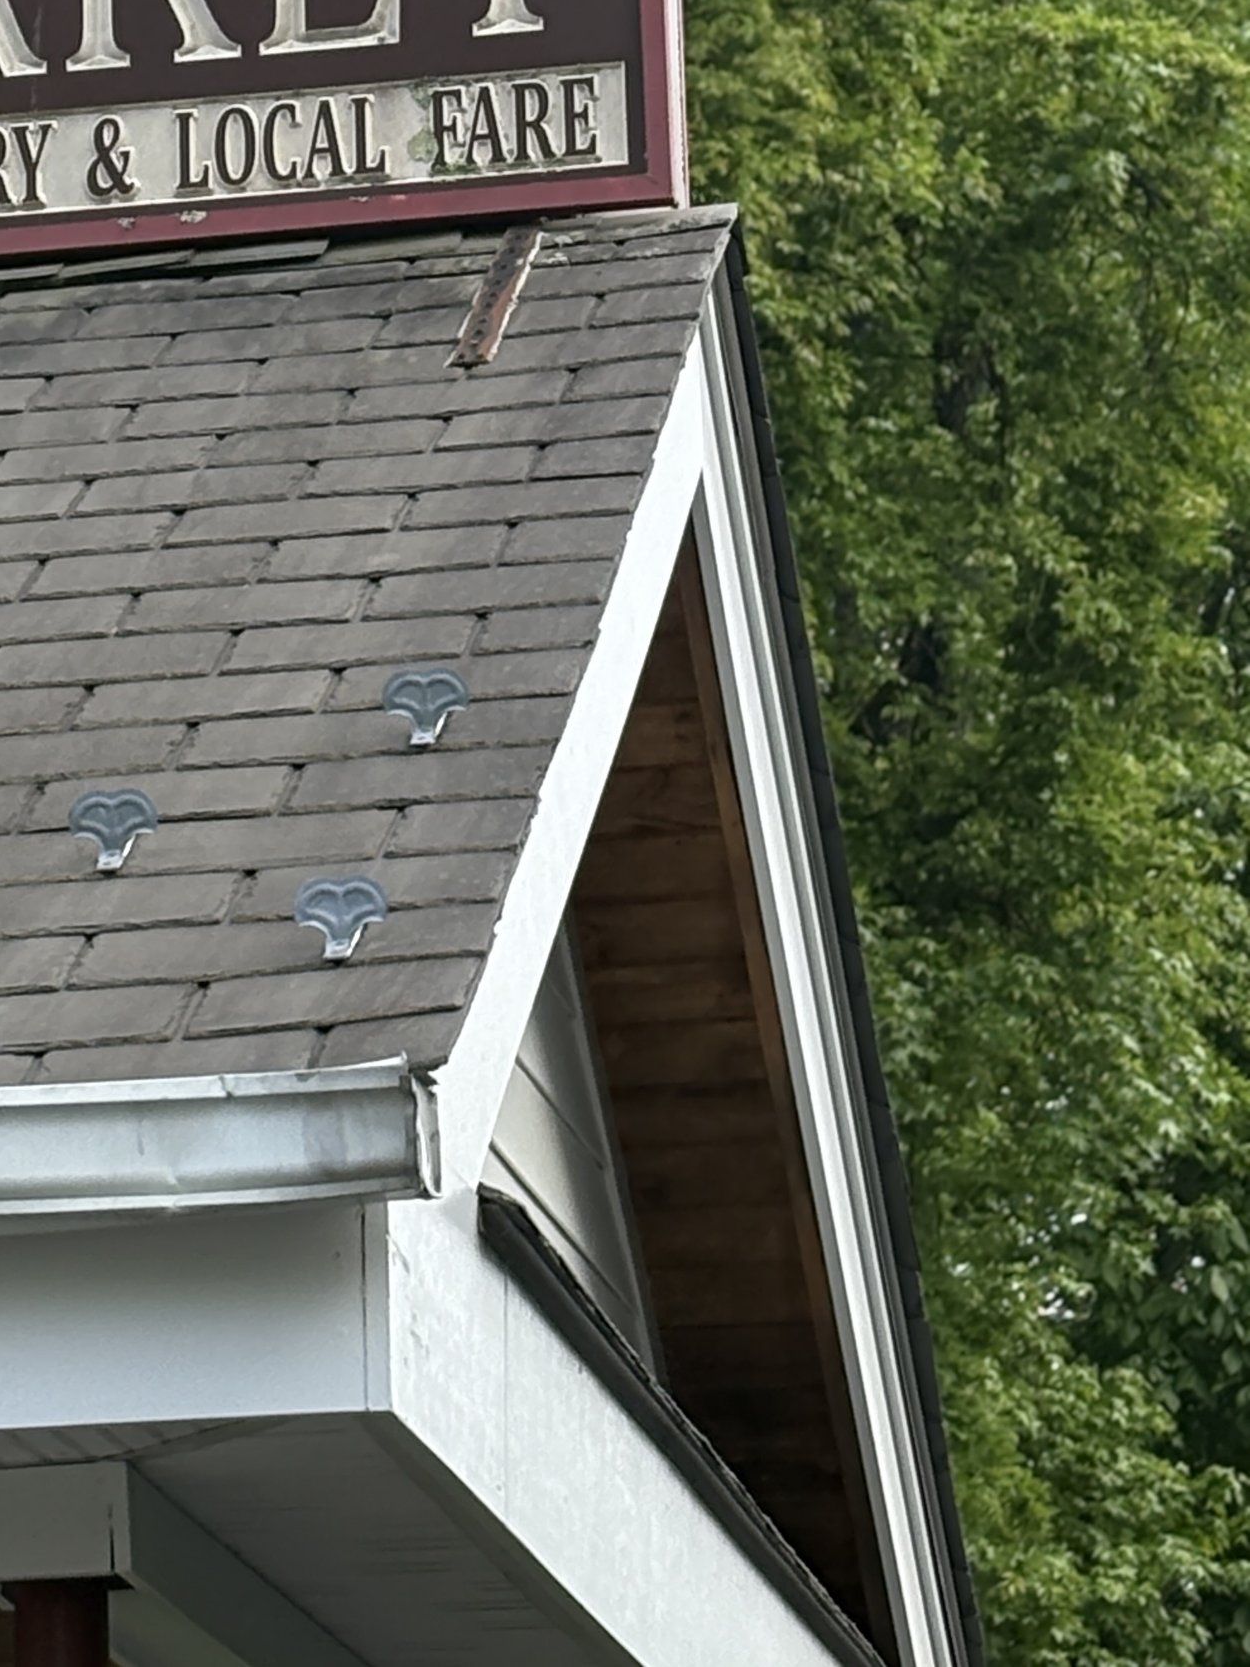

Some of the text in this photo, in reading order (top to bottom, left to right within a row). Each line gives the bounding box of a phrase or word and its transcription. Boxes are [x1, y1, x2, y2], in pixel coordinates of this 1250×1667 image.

[86, 115, 139, 197] &
[174, 94, 388, 190] LOCAL
[430, 74, 601, 168] FARE
